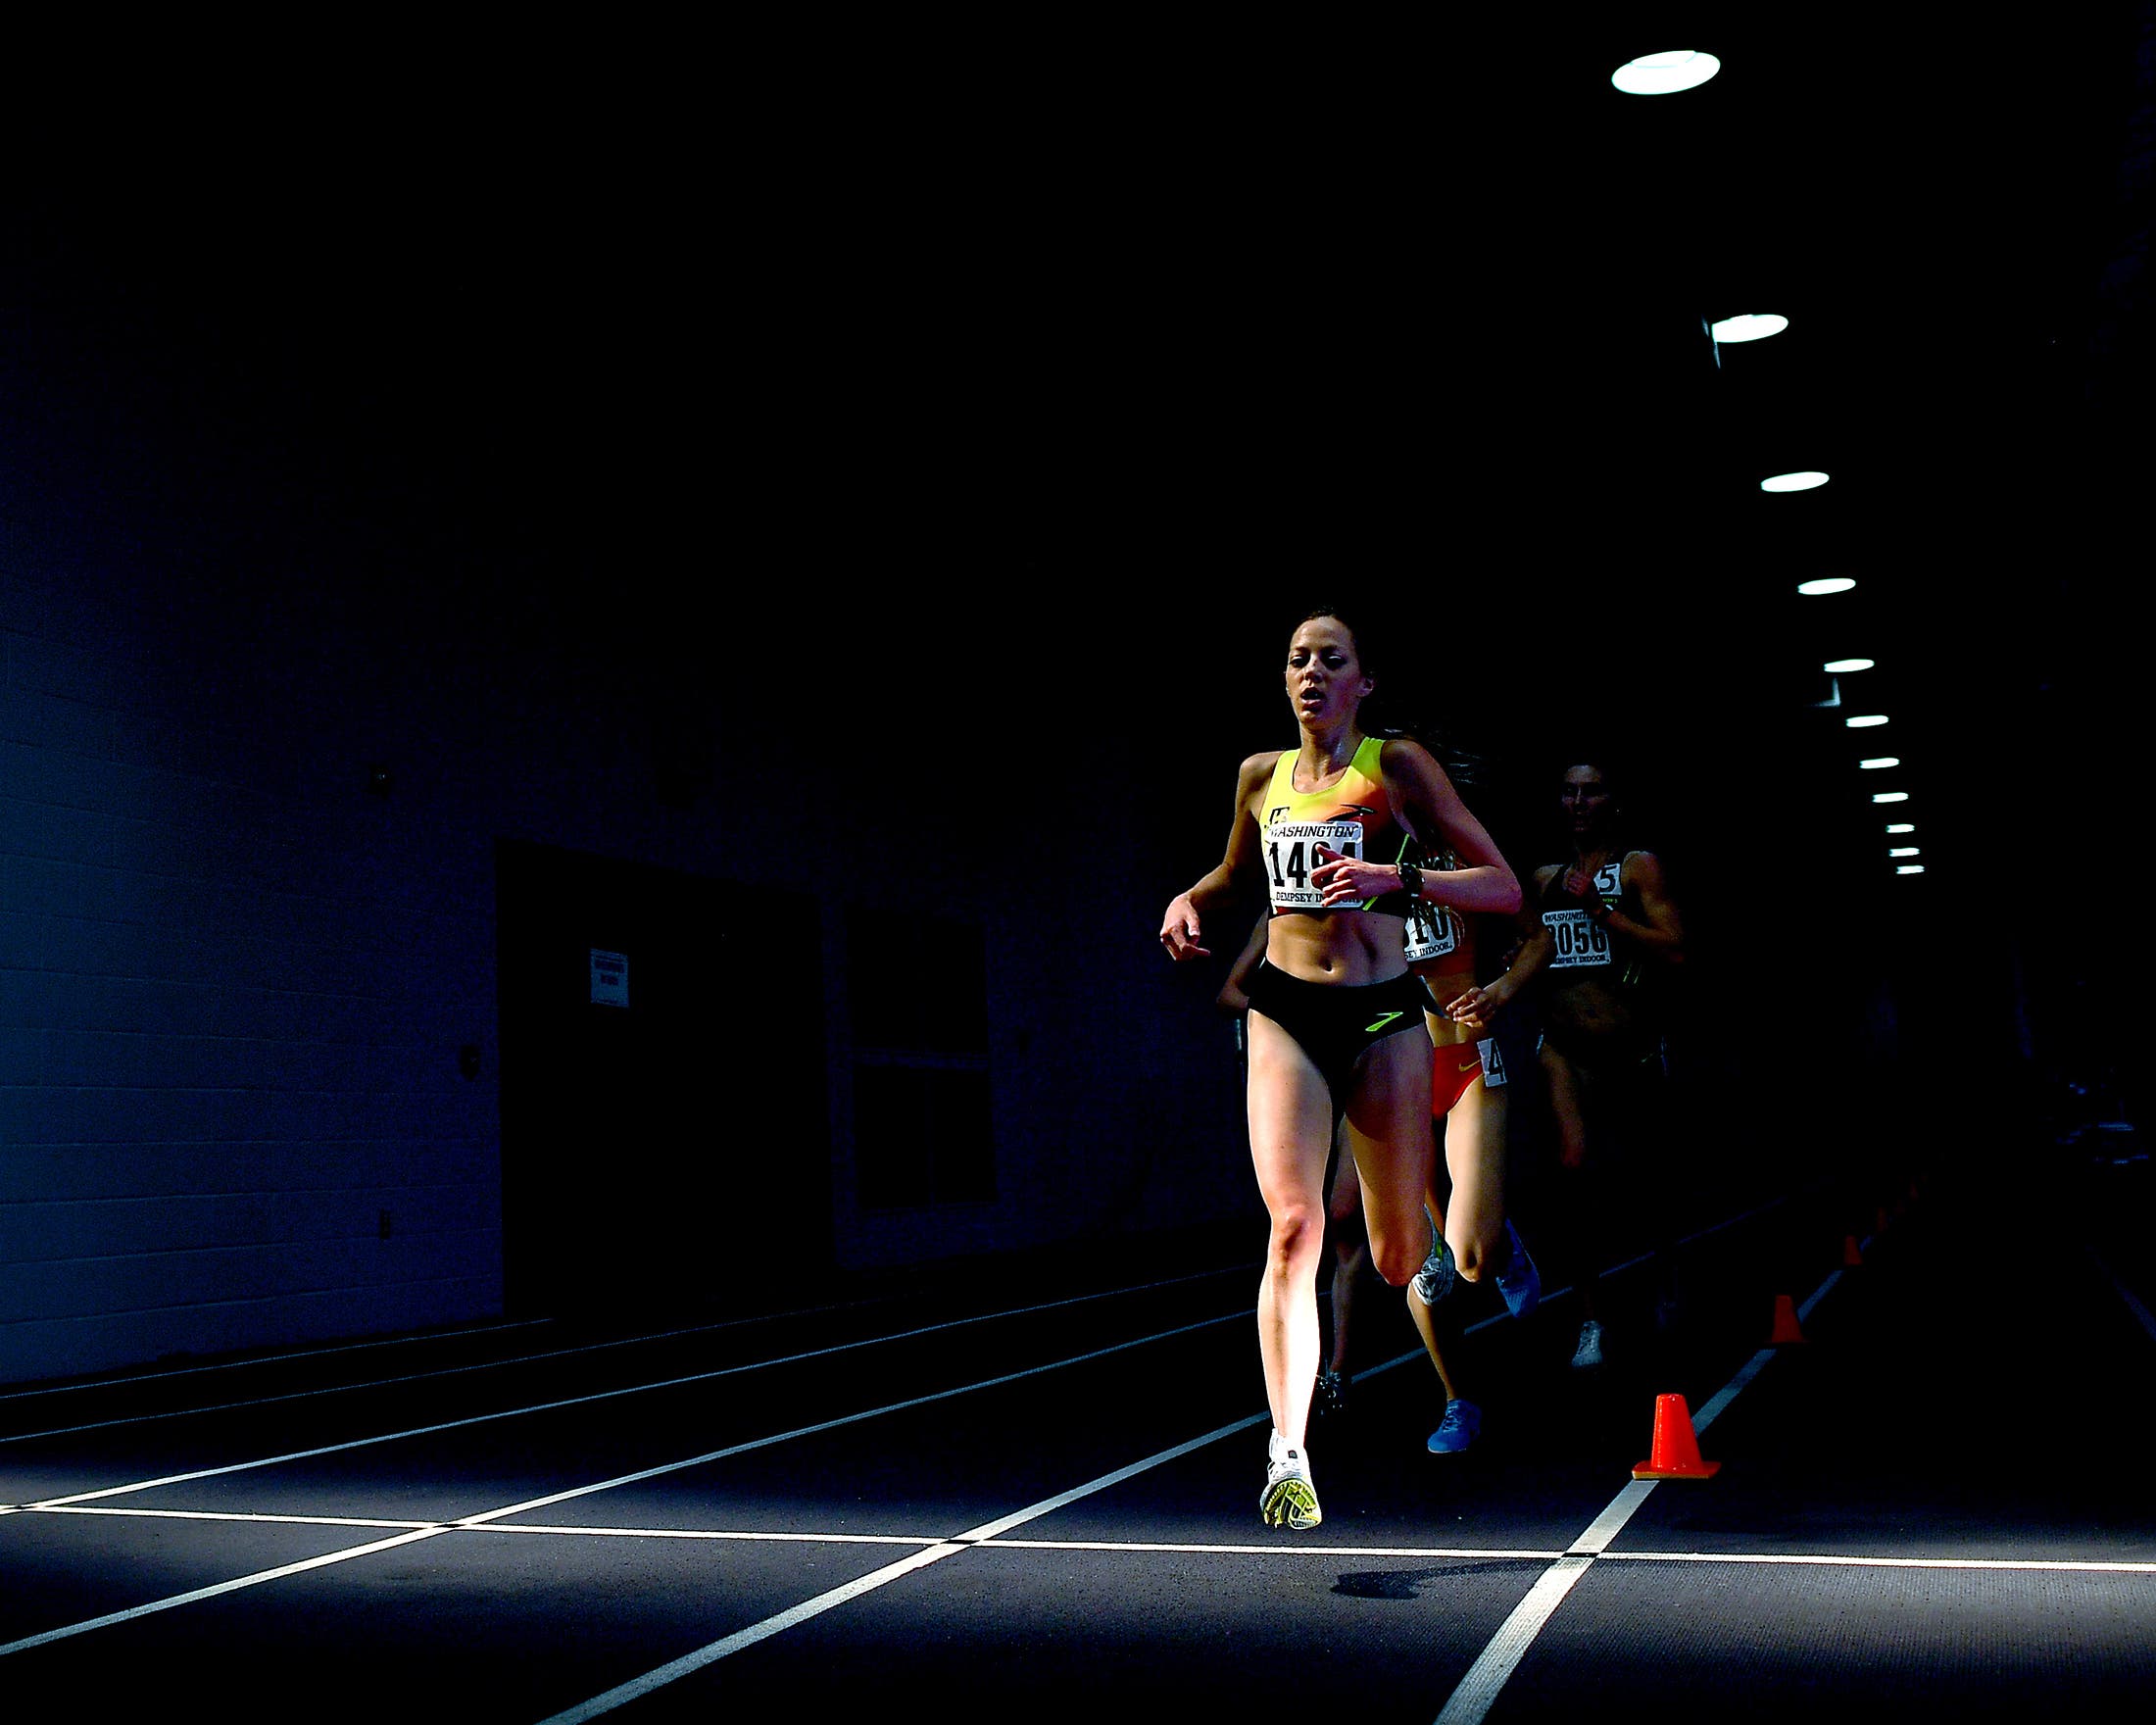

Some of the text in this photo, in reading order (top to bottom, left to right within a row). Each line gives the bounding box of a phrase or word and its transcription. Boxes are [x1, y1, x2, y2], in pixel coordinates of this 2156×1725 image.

[1598, 865, 1617, 893] 5
[1276, 892, 1313, 903] DEMPSEY
[1488, 1039, 1505, 1083] 4
